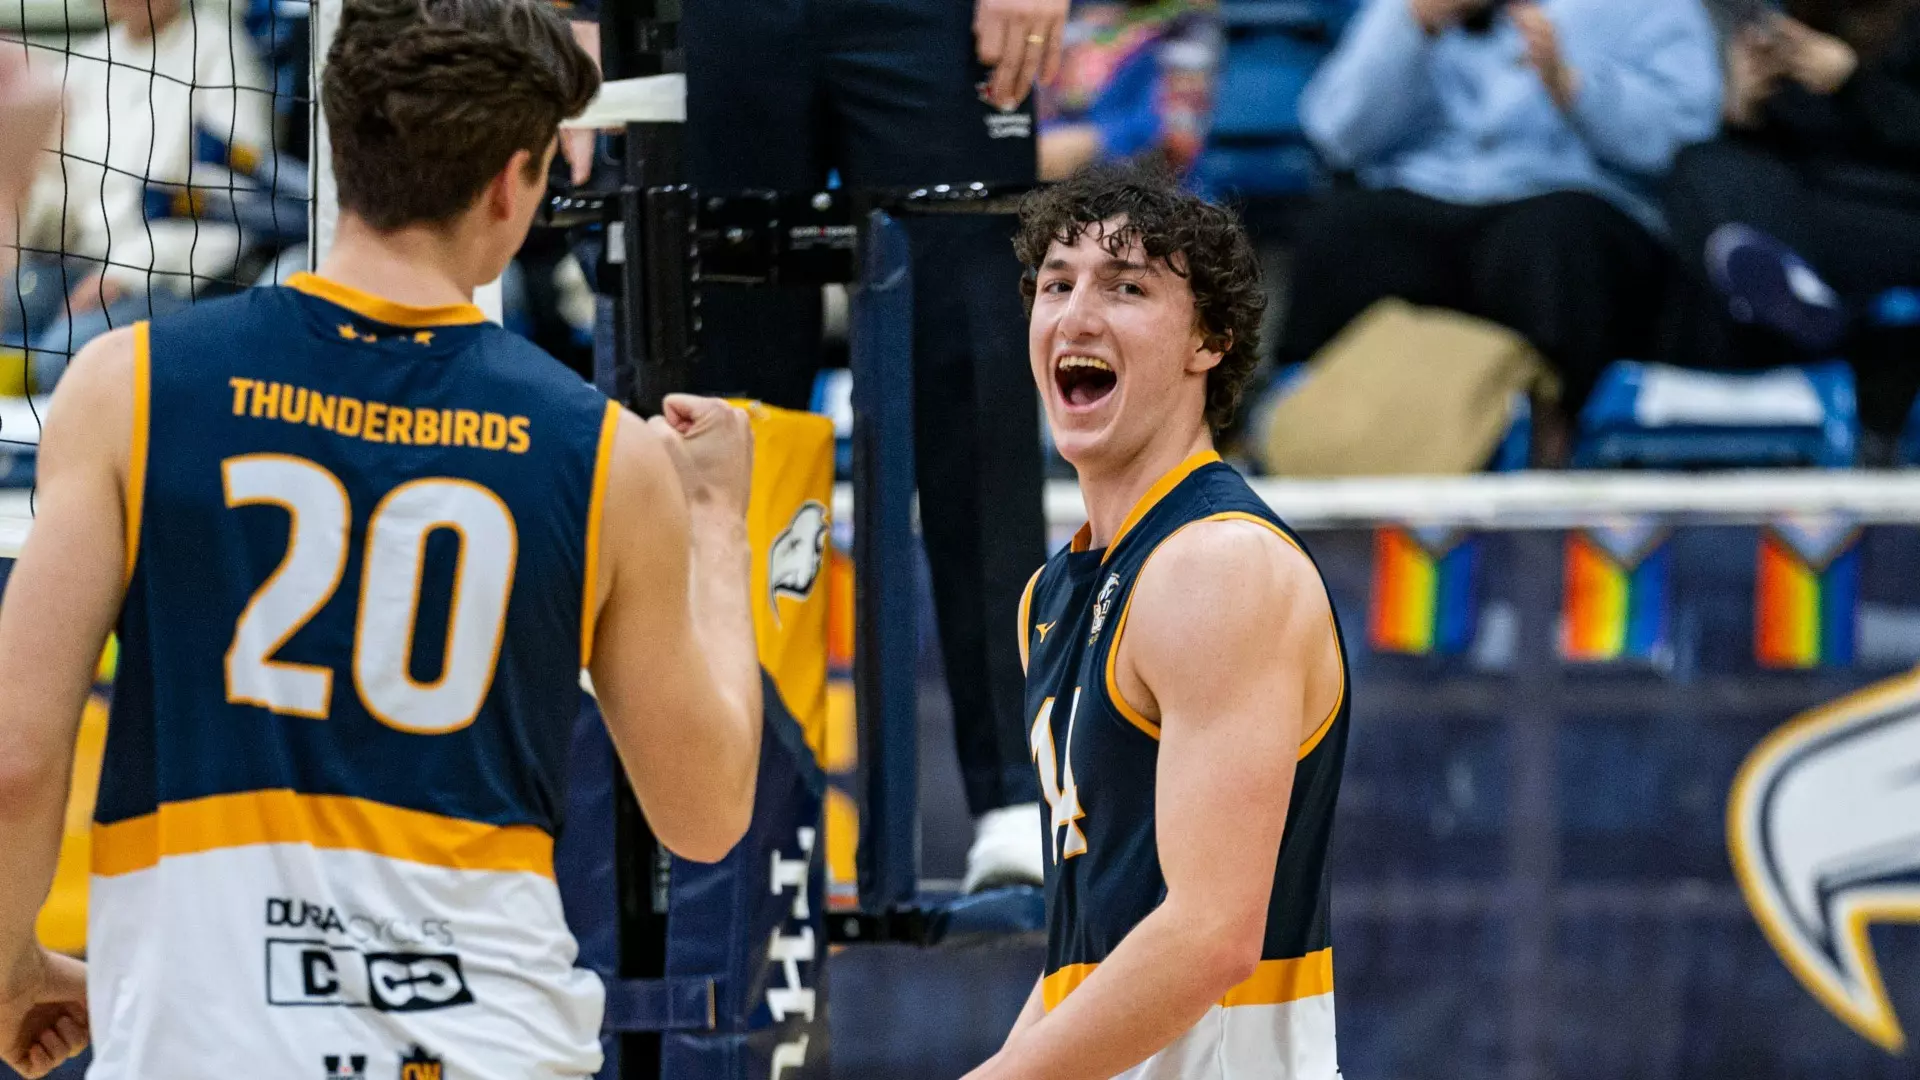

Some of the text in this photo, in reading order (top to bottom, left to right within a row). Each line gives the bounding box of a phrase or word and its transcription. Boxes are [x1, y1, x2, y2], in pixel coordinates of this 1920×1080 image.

[229, 376, 531, 454] THUNDERBIRDS
[220, 452, 518, 735] 20
[1031, 686, 1087, 866] 14
